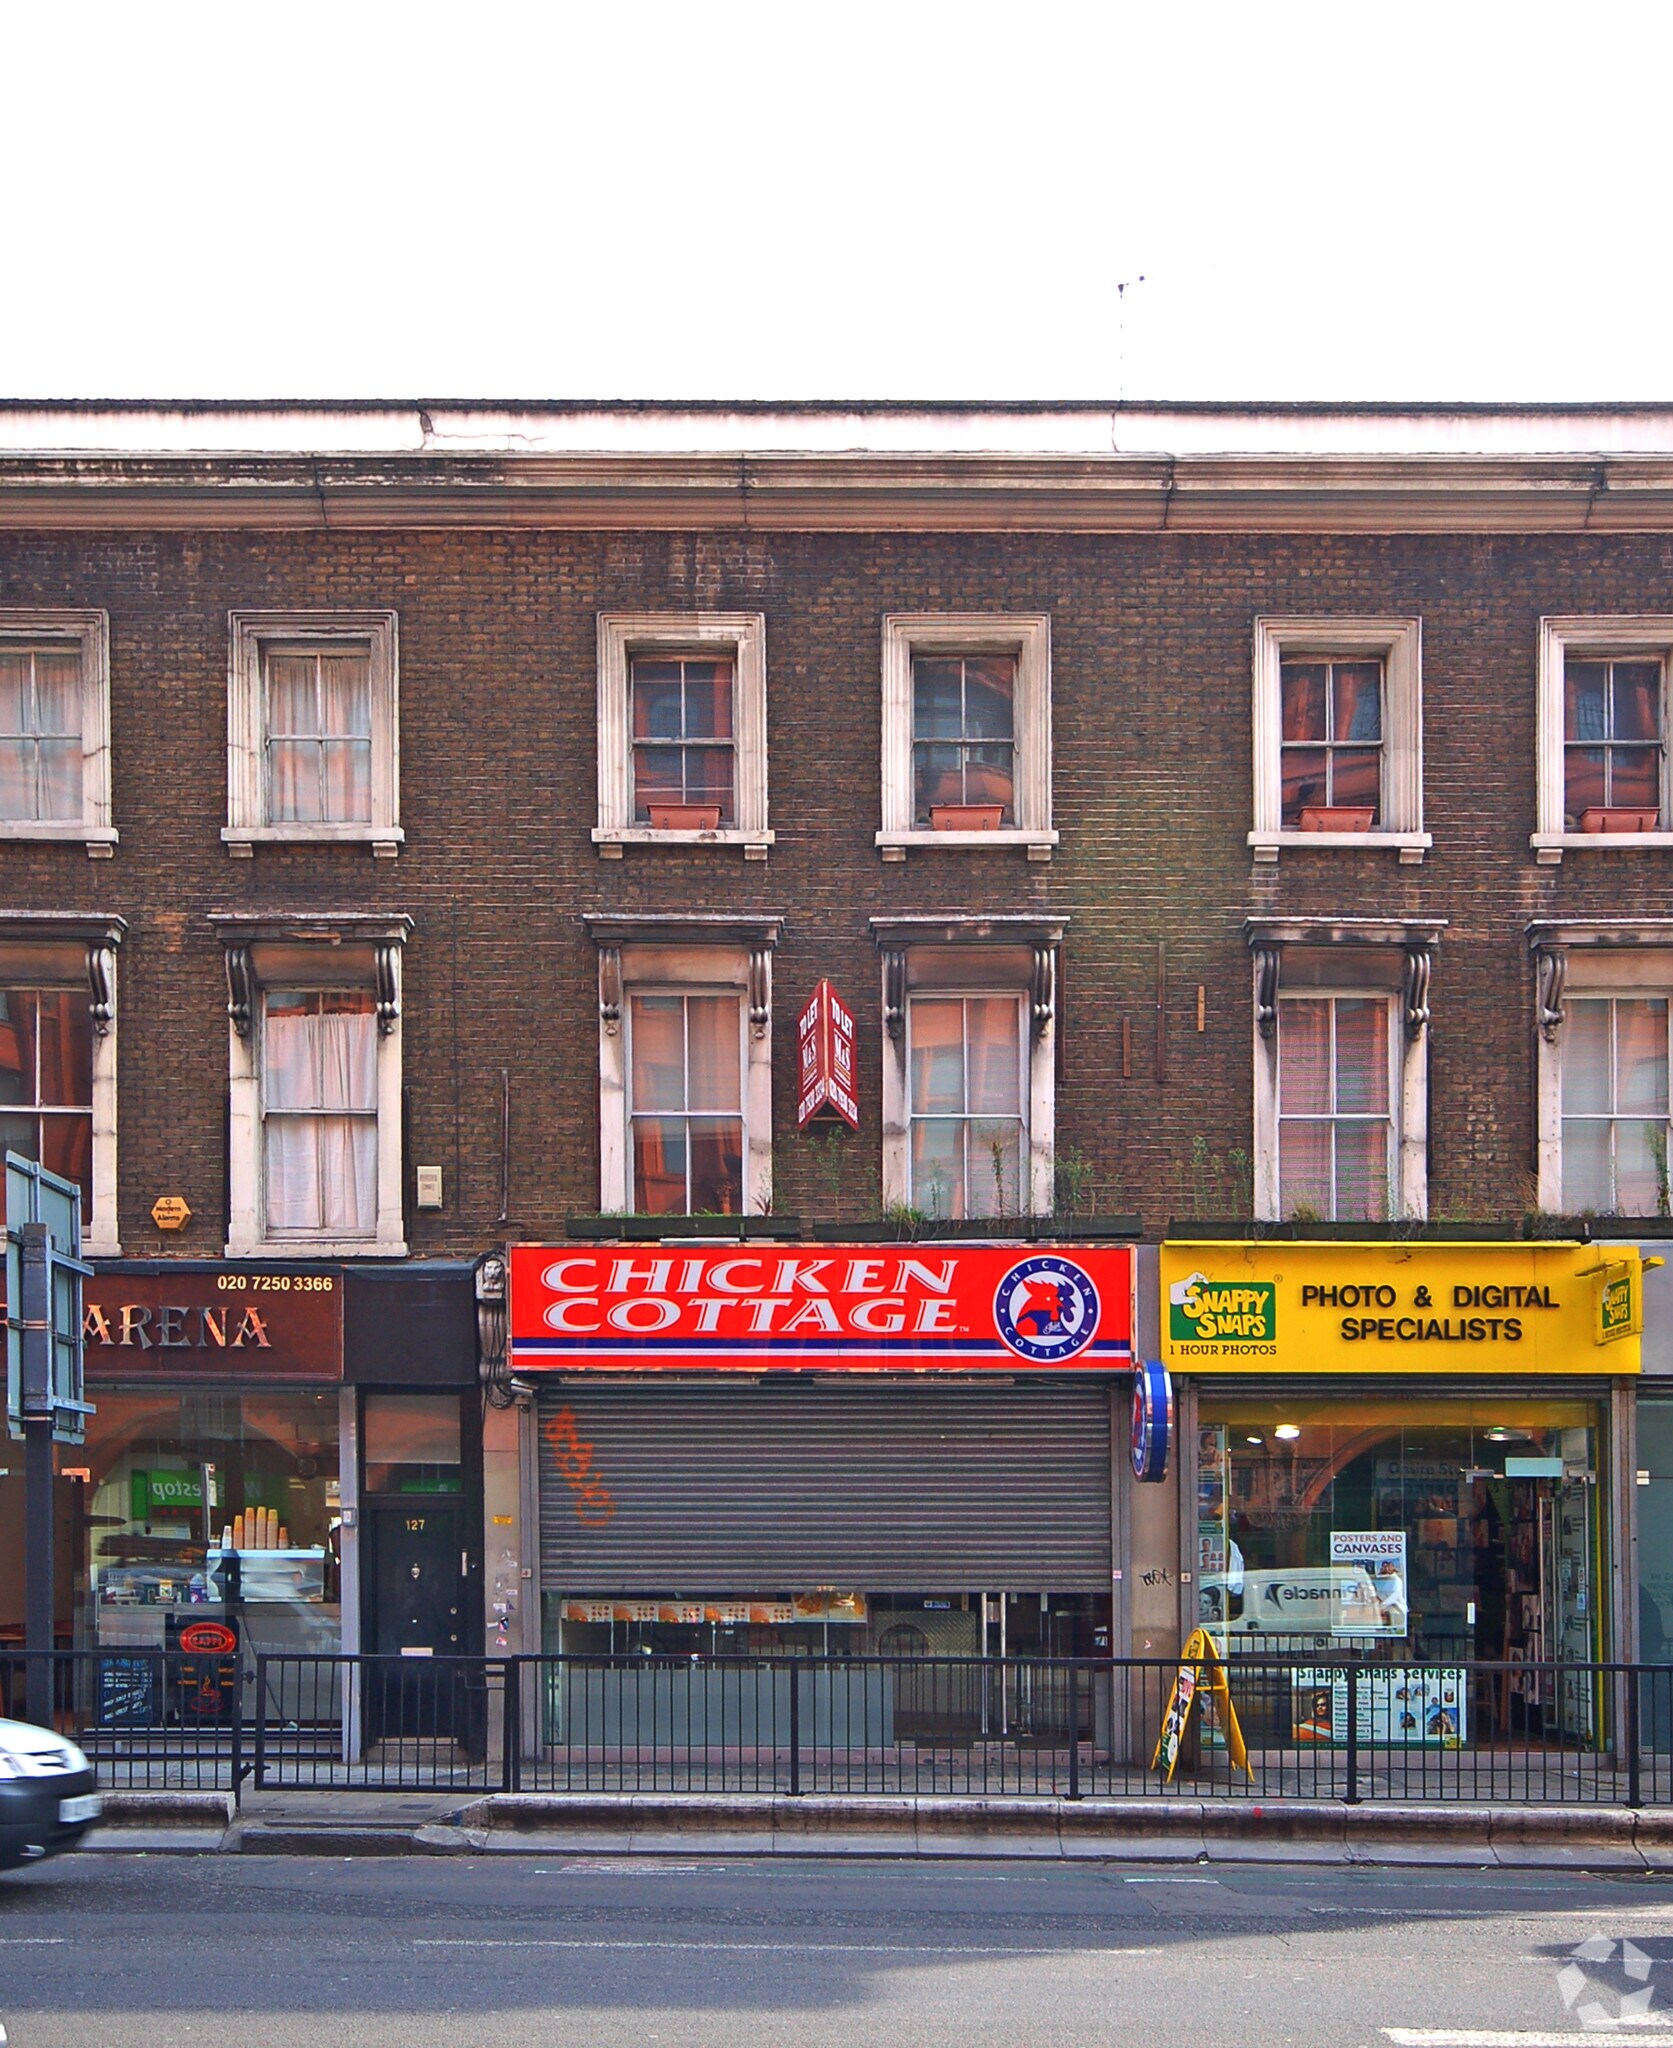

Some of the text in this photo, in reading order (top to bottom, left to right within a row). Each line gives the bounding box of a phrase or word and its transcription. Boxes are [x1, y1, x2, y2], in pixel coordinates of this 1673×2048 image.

[800, 997, 818, 1040] TO LET
[831, 997, 853, 1039] TO LET
[217, 1275, 333, 1291] 020 7250 3366
[540, 1258, 960, 1294] CHICKEN
[1001, 1260, 1093, 1297] CHICKEN
[1182, 1285, 1270, 1319] SNAPPY
[1302, 1285, 1560, 1309] PHOTO & DIGITAL
[83, 1304, 272, 1350] ARENA
[542, 1298, 959, 1332] COTTAGE
[1195, 1313, 1267, 1339] SNAPS
[1341, 1317, 1522, 1341] SPECIALISTS
[1004, 1326, 1089, 1356] COTTAGE
[1170, 1345, 1277, 1355] 1 HOUR PHOTOS
[406, 1519, 425, 1531] 127
[1333, 1534, 1403, 1543] POSTERS AND
[1333, 1543, 1403, 1554] CANVASES
